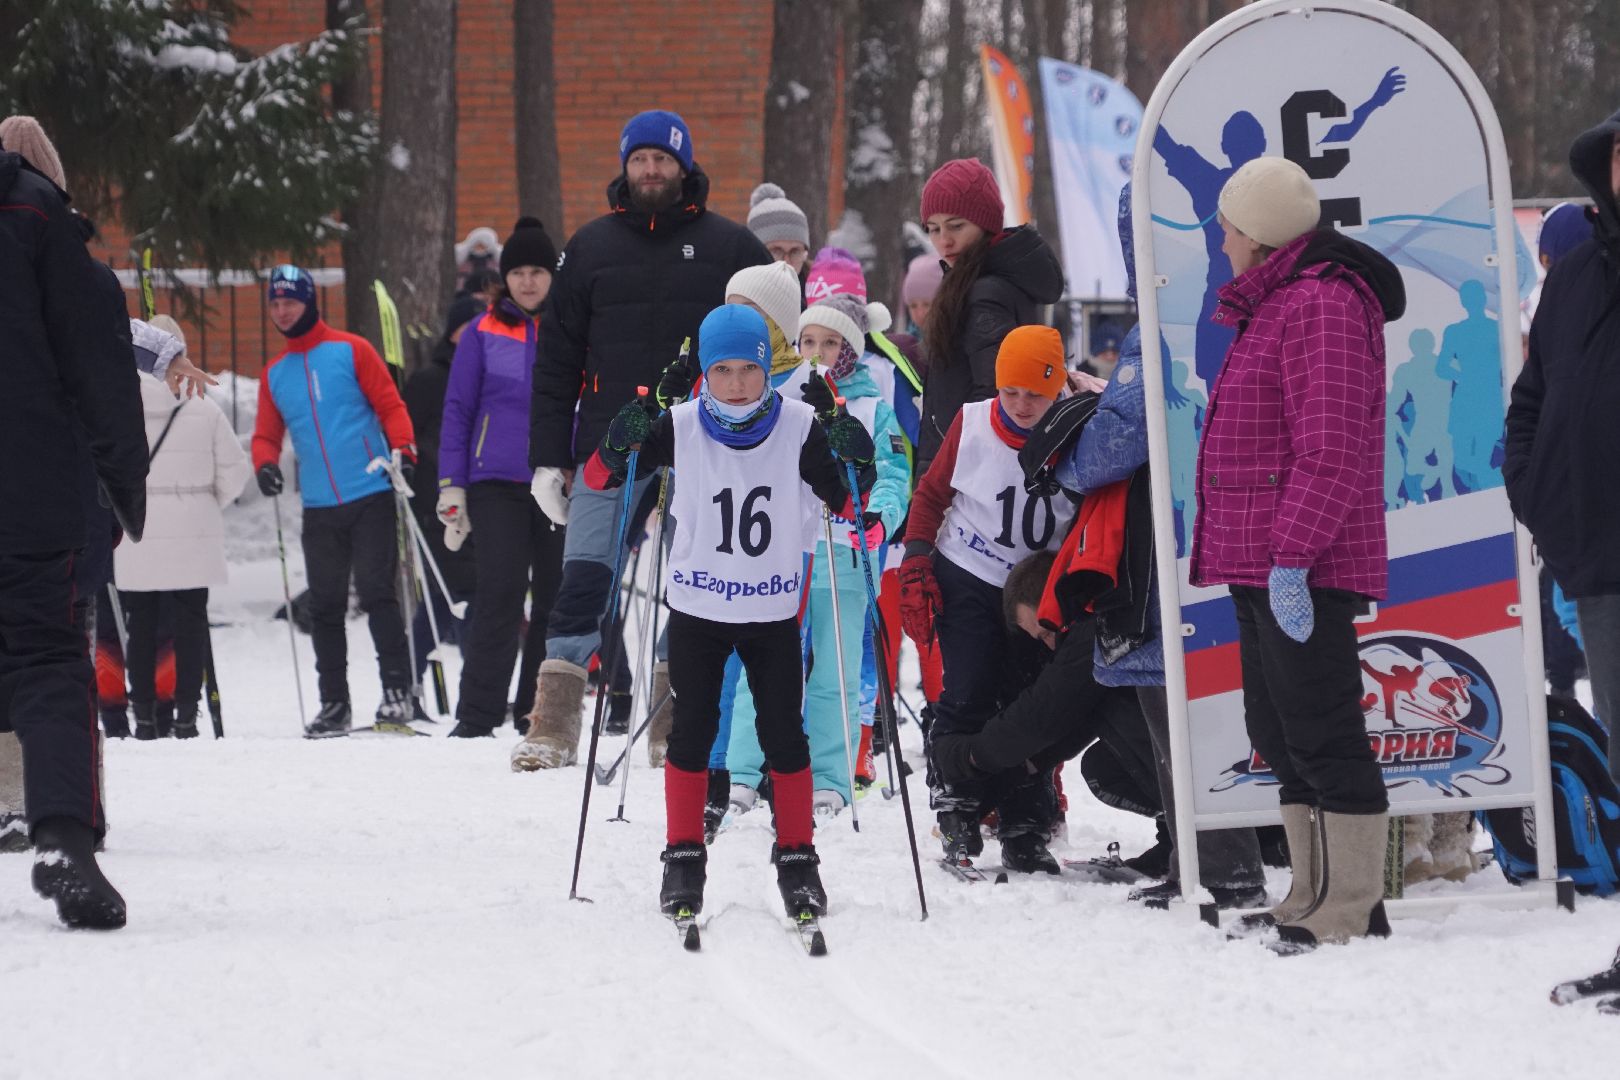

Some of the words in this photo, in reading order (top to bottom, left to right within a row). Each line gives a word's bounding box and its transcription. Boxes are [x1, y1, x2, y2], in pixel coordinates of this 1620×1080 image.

[712, 485, 772, 558] 16
[993, 485, 1056, 551] 10
[779, 853, 809, 863] spine
